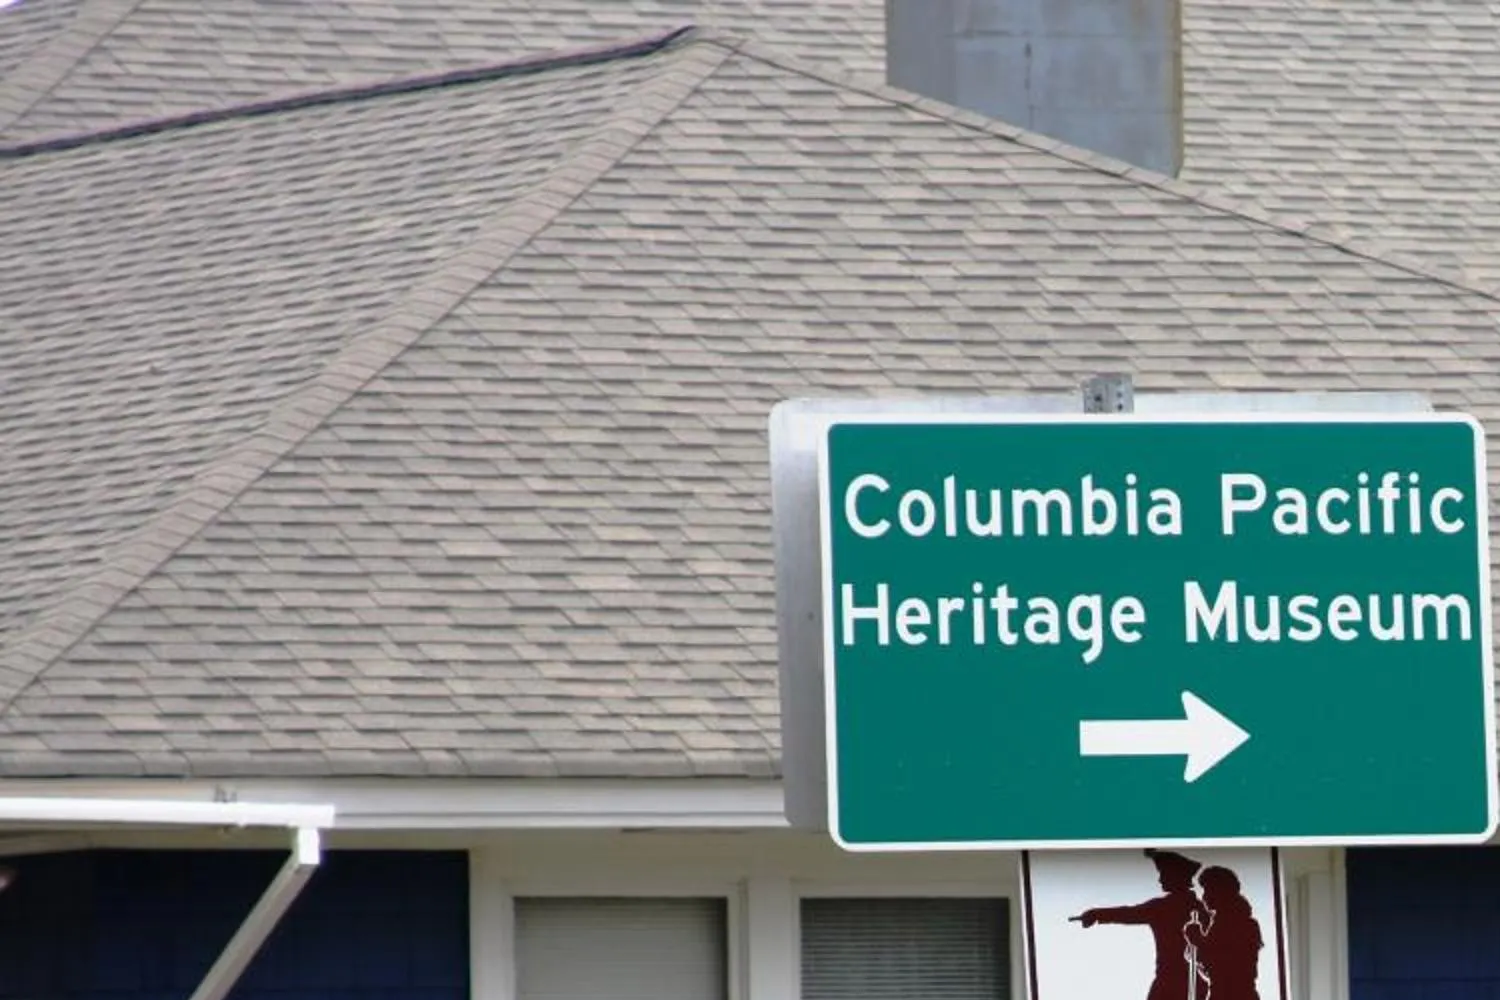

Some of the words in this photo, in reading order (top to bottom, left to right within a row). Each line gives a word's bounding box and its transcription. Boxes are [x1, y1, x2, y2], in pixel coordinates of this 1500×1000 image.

[845, 473, 1183, 538] Columbia
[1220, 472, 1466, 535] Pacific
[841, 582, 1146, 664] Heritage
[1183, 580, 1472, 643] Museum
